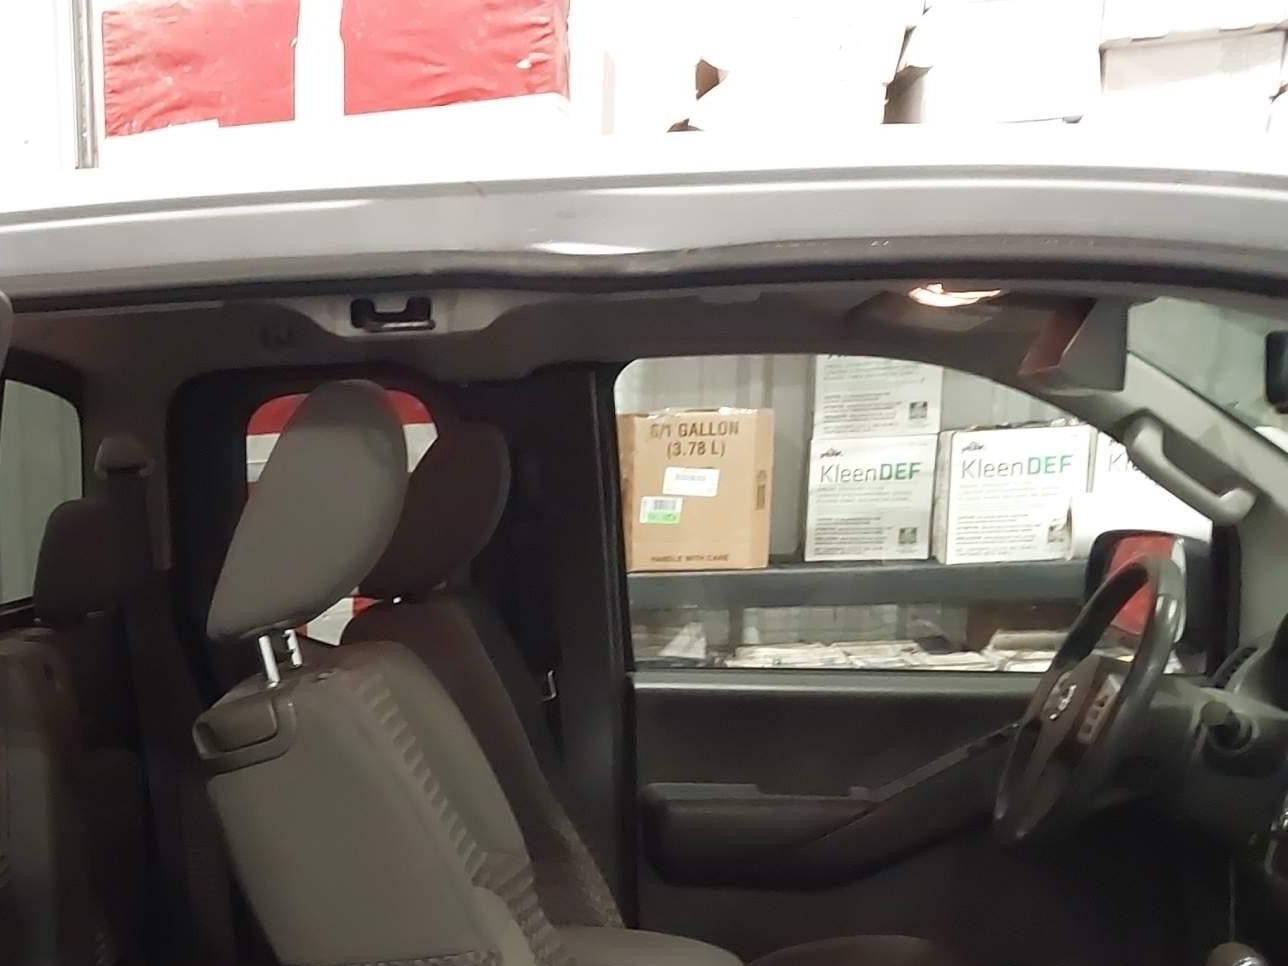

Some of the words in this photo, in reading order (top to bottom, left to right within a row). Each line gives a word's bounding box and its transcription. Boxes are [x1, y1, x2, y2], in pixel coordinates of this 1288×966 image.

[678, 421, 740, 438] GALLON
[667, 441, 706, 459] (3.78
[711, 440, 726, 457] L)
[820, 462, 921, 483] KleenDEF
[962, 454, 1073, 479] KleenDEF
